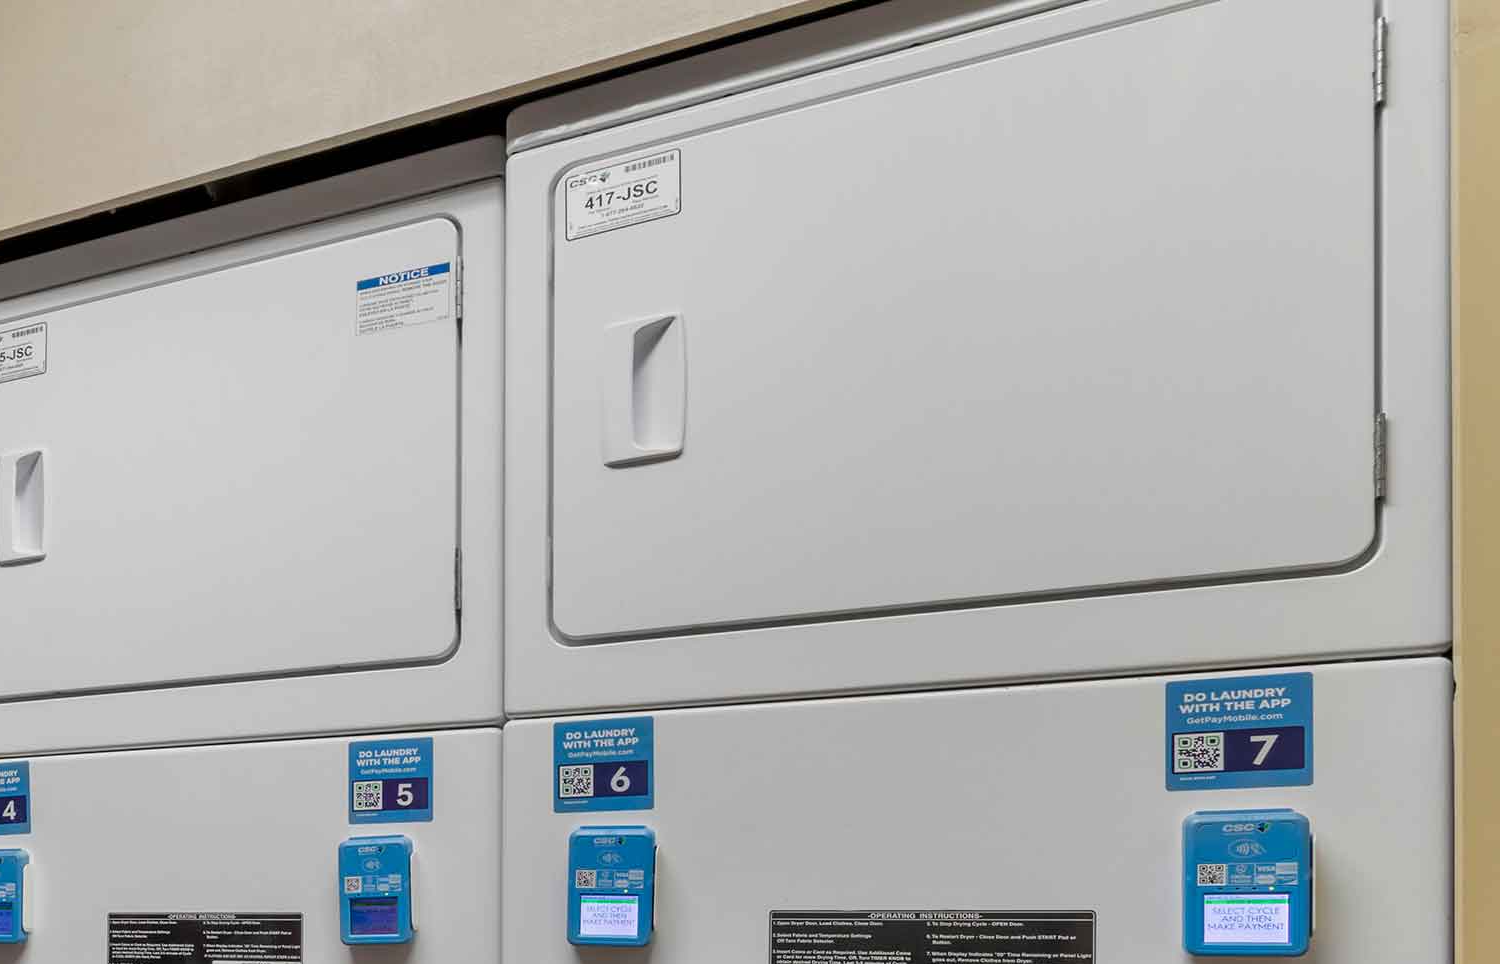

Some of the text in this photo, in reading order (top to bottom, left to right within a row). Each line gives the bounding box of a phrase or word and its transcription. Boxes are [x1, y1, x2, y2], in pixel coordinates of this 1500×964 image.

[584, 180, 659, 210] 417-JSC
[379, 267, 430, 286] NOTICE
[1183, 687, 1287, 704] DO LAUNDRY
[1179, 697, 1292, 714] WITH THE APP
[1187, 712, 1284, 726] GetPayMobile.com
[565, 728, 636, 741] DO LAUNDRY
[563, 737, 639, 750] WITH THE APP
[1249, 734, 1279, 767] 7
[356, 756, 421, 767] WITH THE APP
[358, 747, 419, 759] DO LAUNDRY
[6, 777, 21, 786] APP
[609, 766, 631, 793] 6
[396, 783, 414, 808] 5
[2, 800, 17, 821] 4
[1222, 823, 1255, 833] CSC
